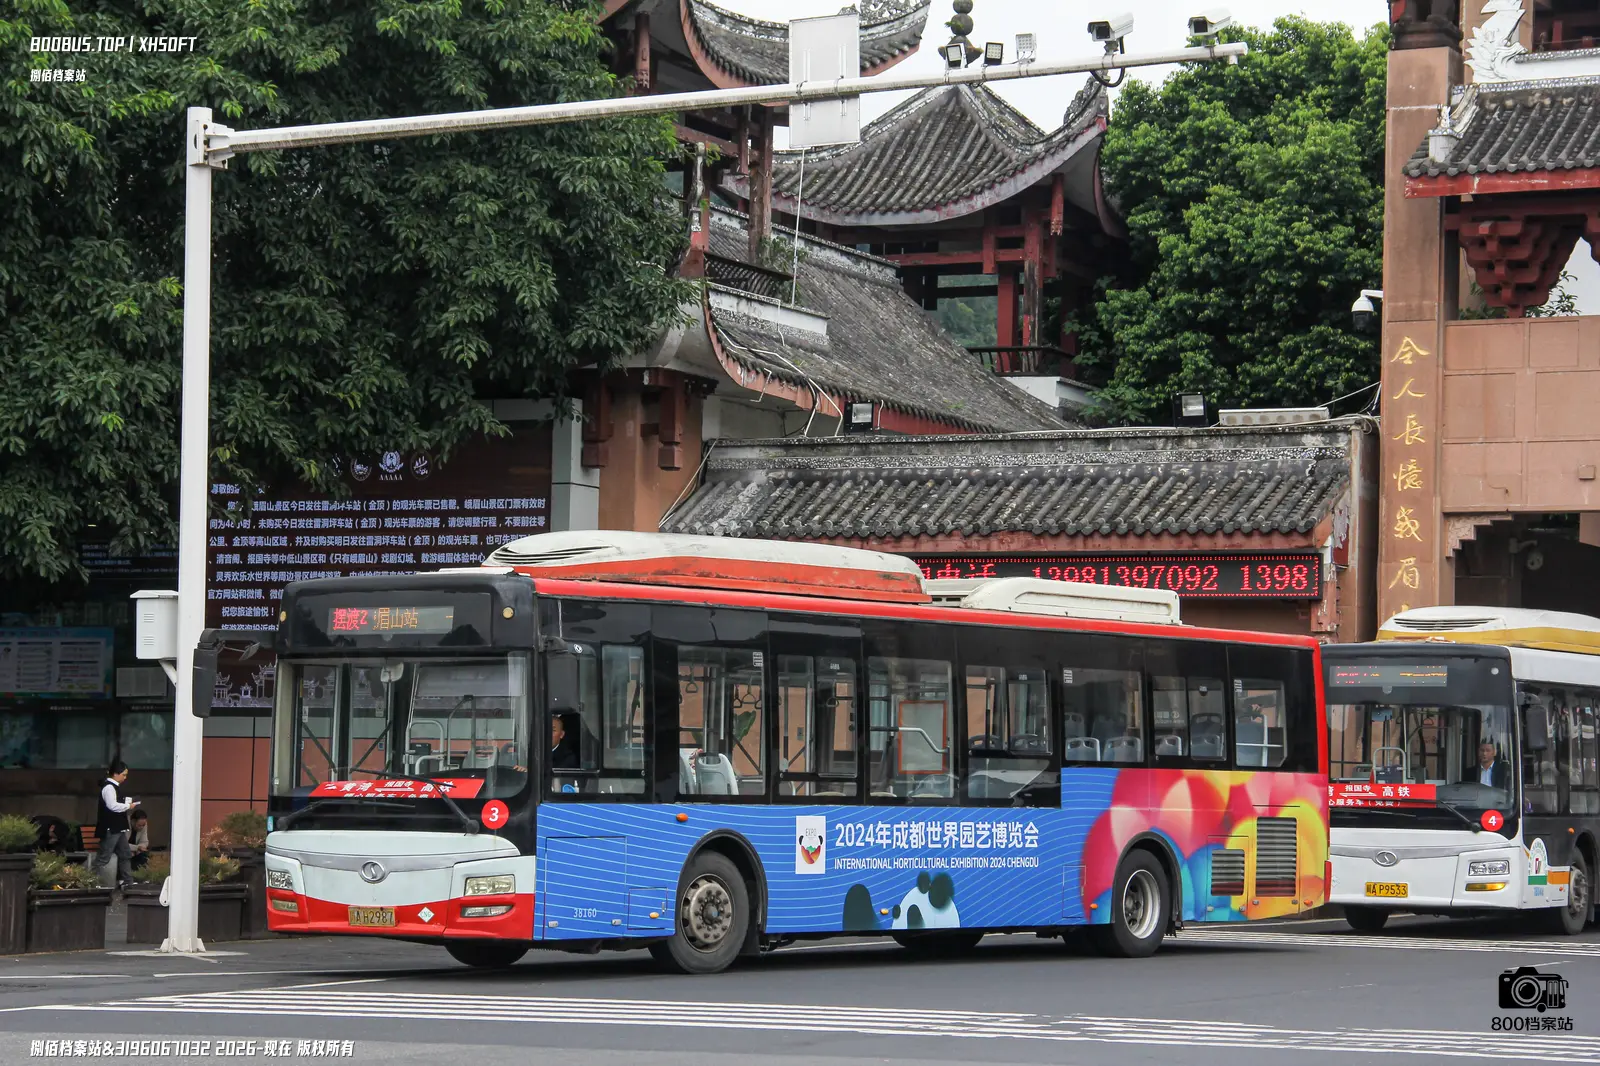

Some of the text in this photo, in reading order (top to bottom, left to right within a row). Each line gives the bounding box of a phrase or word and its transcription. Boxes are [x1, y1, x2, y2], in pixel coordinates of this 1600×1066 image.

[1345, 784, 1371, 793] 报国寺
[1381, 785, 1411, 798] 高铁
[488, 807, 499, 822] 3
[1488, 815, 1497, 827] 4
[805, 827, 817, 837] EXPO
[834, 821, 1040, 850] 2024年成都世界园艺博览会
[834, 857, 1040, 870] INTERNATIONAL HORTICULTURAL EXHIBITION 2024 CHENGDU
[573, 908, 597, 918] 38160
